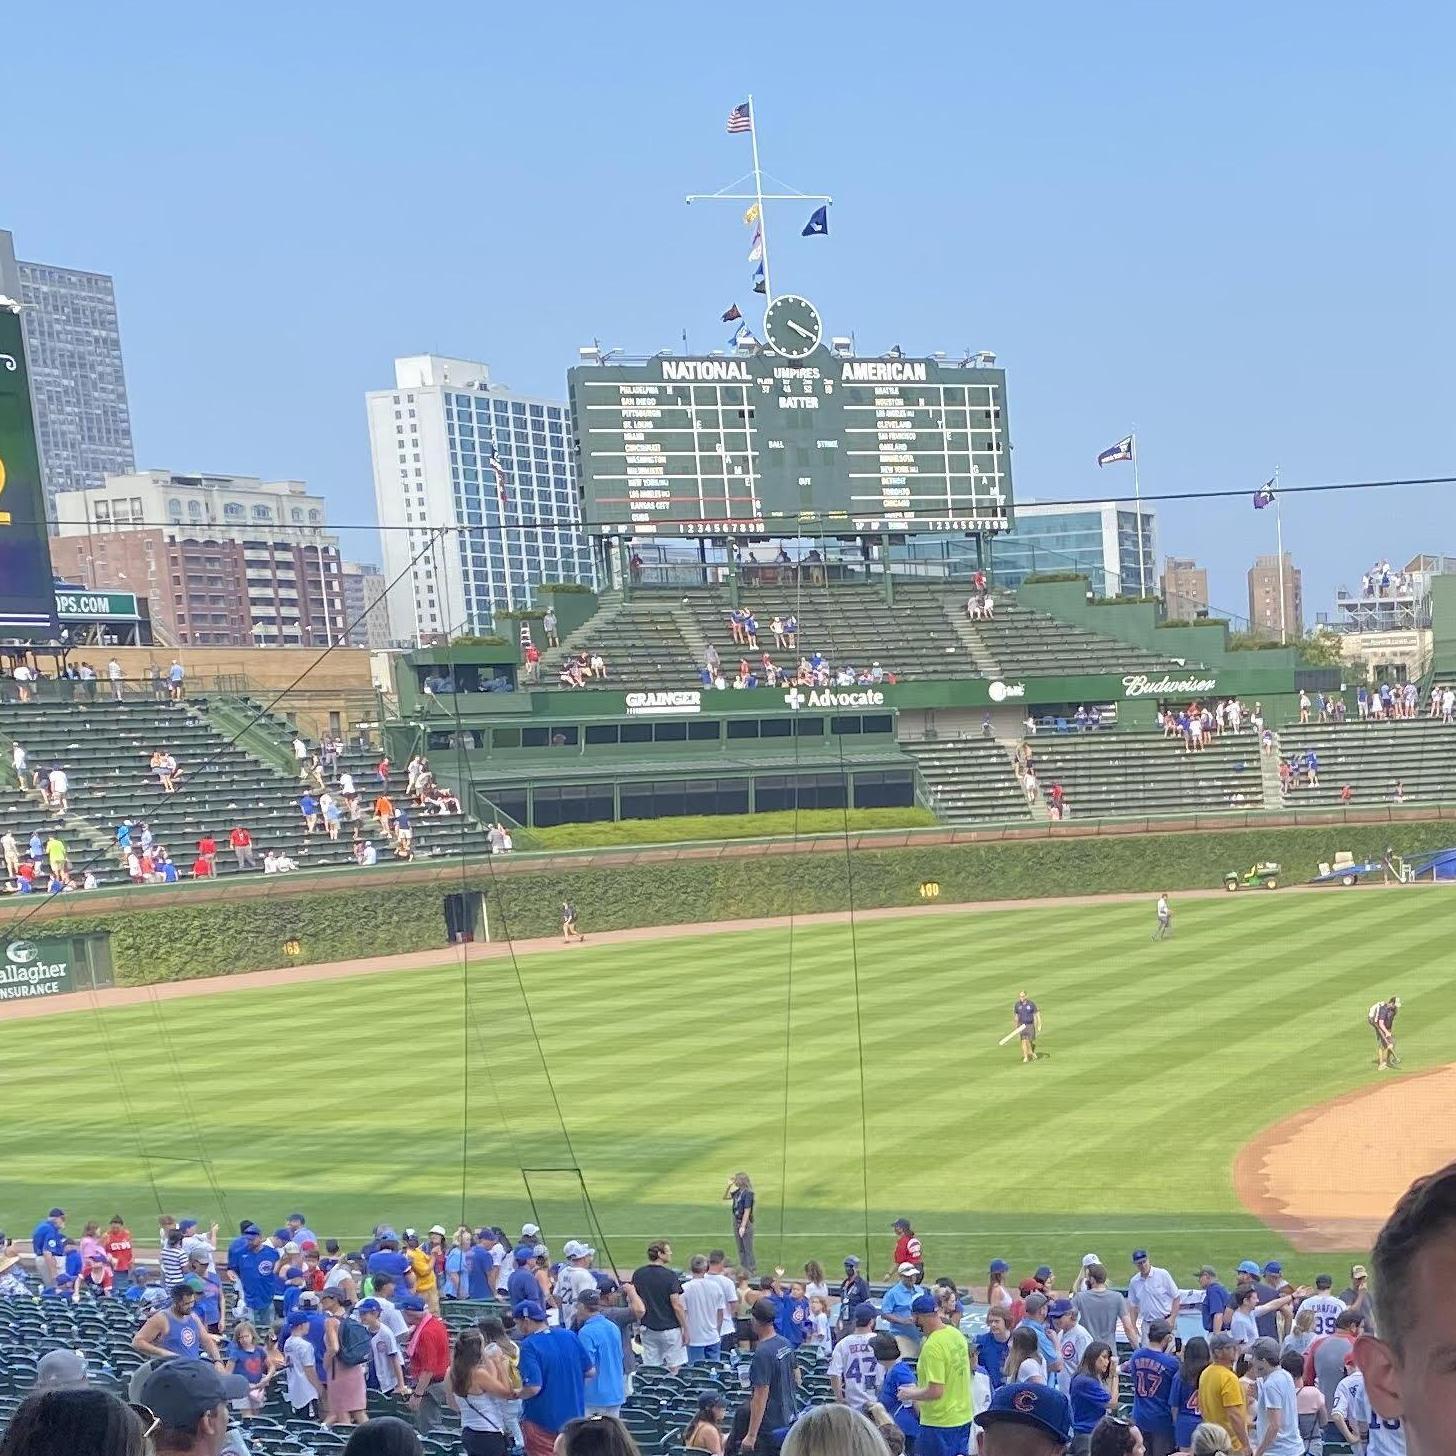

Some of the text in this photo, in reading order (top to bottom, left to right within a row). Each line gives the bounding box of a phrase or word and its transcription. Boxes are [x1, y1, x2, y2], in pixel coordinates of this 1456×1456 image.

[662, 361, 752, 380] NATIONAL
[774, 368, 820, 379] UMPIRES
[841, 363, 926, 380] AMERICAN
[779, 397, 819, 408] BATTER
[1122, 675, 1216, 696] Budweiser
[626, 691, 701, 707] GRAINGER
[808, 689, 884, 707] Advocate
[920, 883, 939, 897] 400
[0, 962, 67, 984] allagher
[0, 982, 60, 999] NSURANCE
[846, 1356, 878, 1384] 47
[1136, 1371, 1163, 1397] 17
